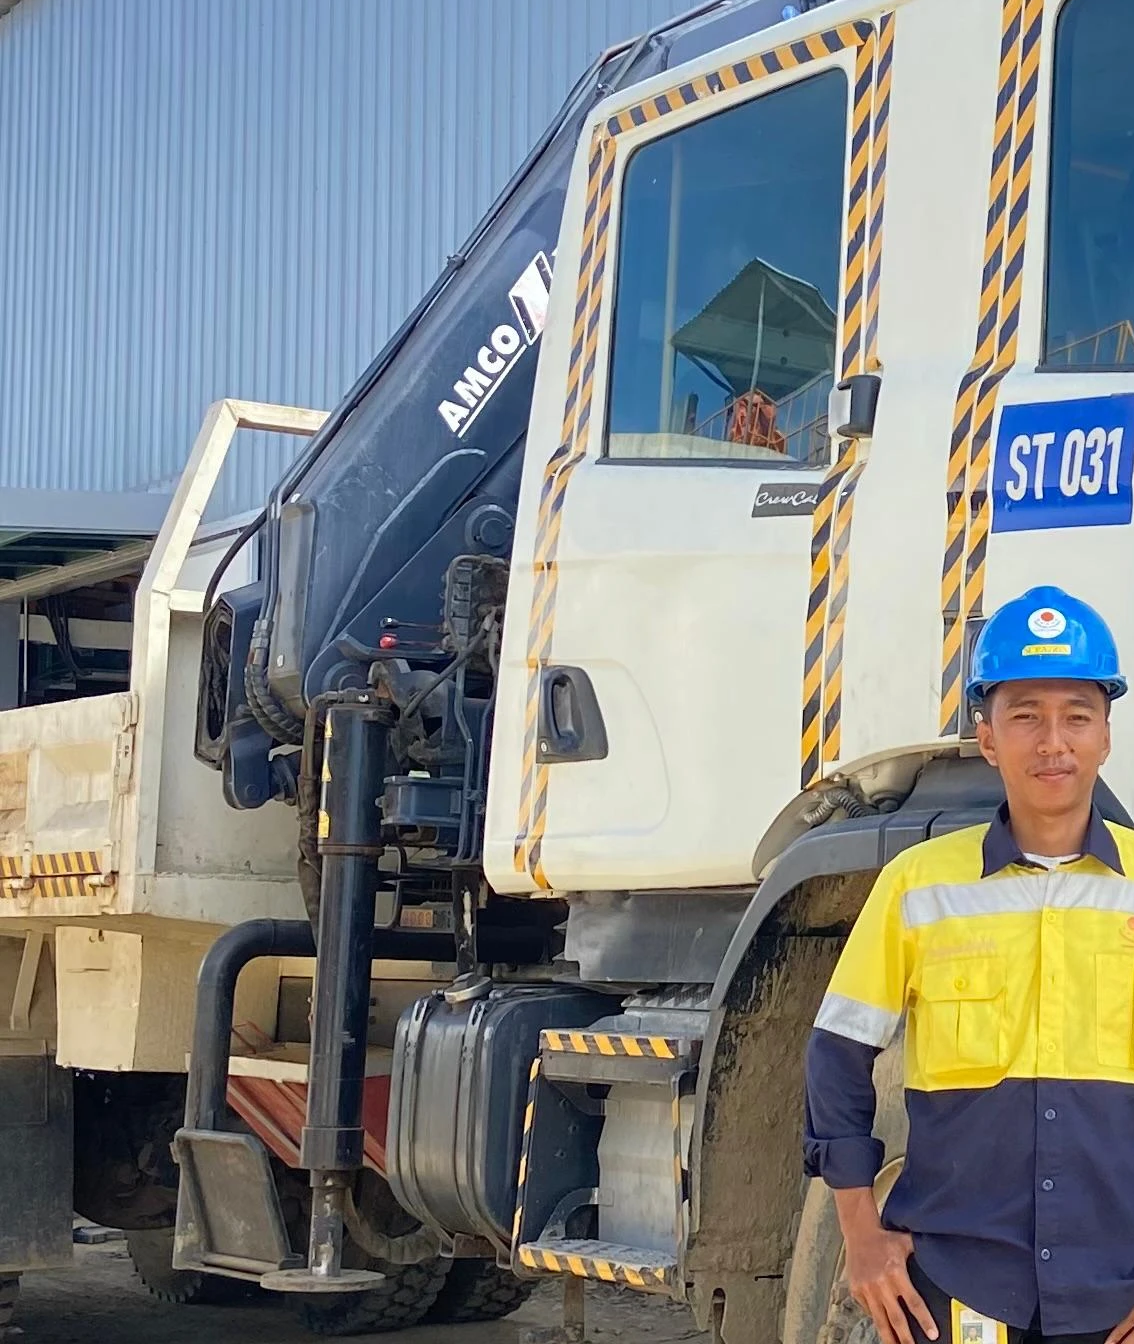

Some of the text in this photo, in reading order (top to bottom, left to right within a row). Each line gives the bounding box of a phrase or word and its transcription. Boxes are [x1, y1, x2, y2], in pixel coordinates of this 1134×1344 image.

[438, 324, 521, 433] AMCO
[1005, 427, 1124, 501] ST 031
